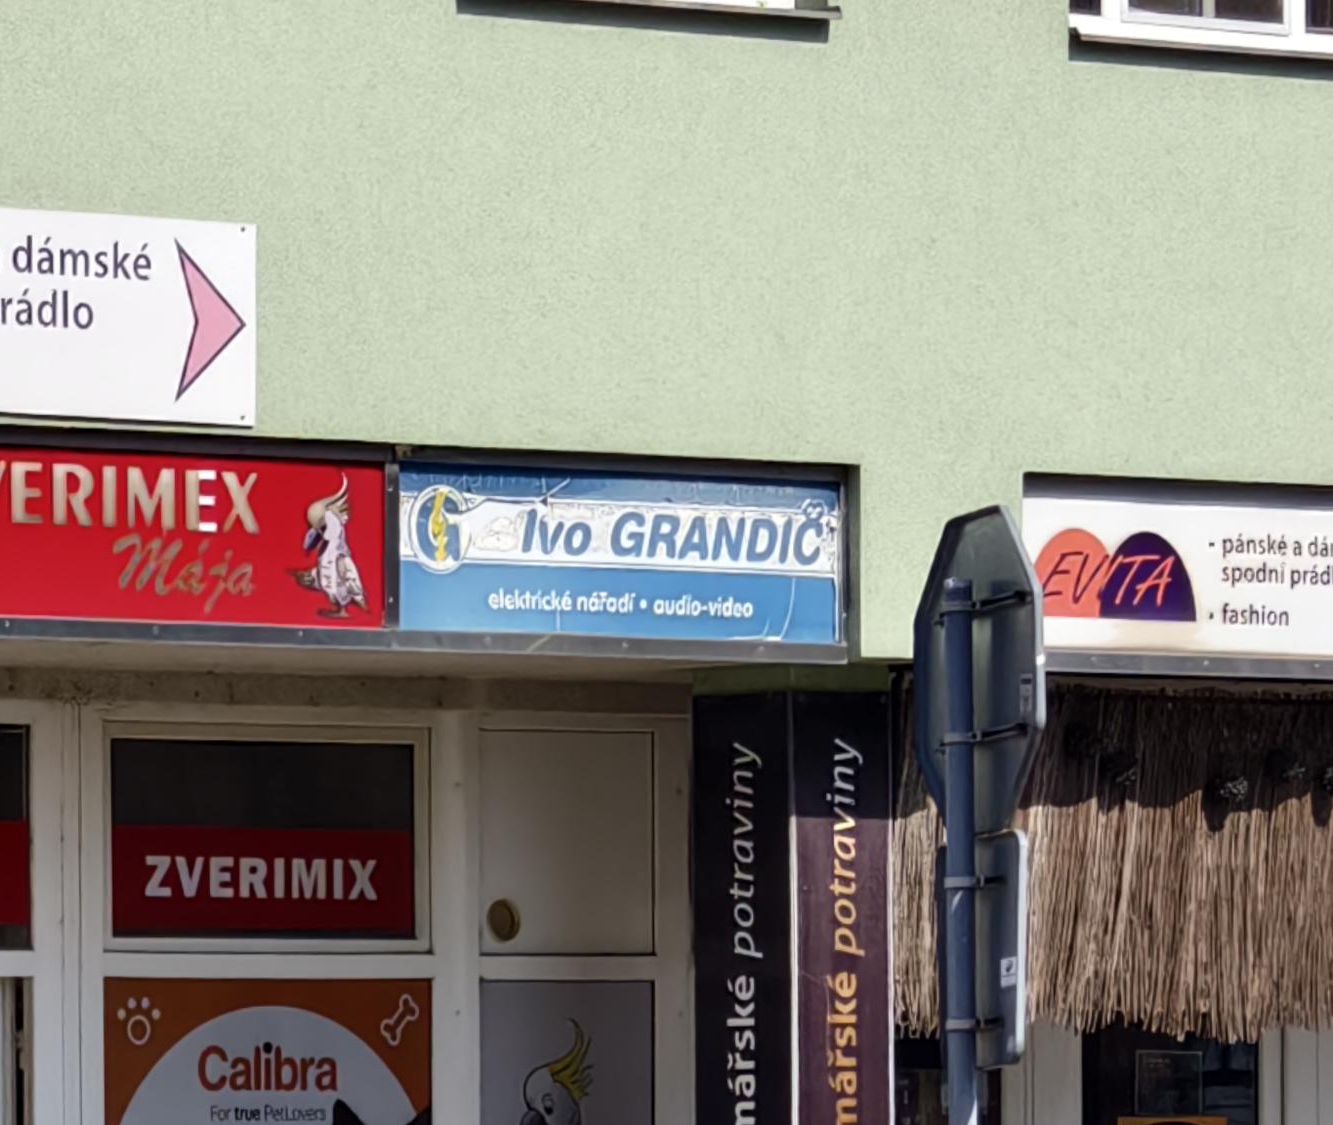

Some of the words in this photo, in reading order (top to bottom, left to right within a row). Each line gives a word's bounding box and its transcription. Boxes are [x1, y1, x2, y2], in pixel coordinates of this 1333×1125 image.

[11, 233, 153, 282] dámské
[521, 508, 592, 555] Ivo
[610, 502, 823, 565] GRANDIČ
[1222, 533, 1288, 559] pánské
[1293, 540, 1303, 556] a
[113, 533, 257, 601] Mája
[1042, 551, 1176, 607] EVITA
[1221, 562, 1286, 588] spodní
[488, 588, 572, 612] elektrické
[576, 592, 634, 614] nářadí
[653, 597, 754, 619] audio-video
[1222, 603, 1290, 626] fashion
[726, 742, 763, 957] potraviny
[826, 738, 865, 956] potraviny
[144, 854, 378, 901] ZVERIMIX
[197, 1041, 338, 1092] Calibra
[210, 1105, 231, 1121] For
[234, 1106, 261, 1121] true
